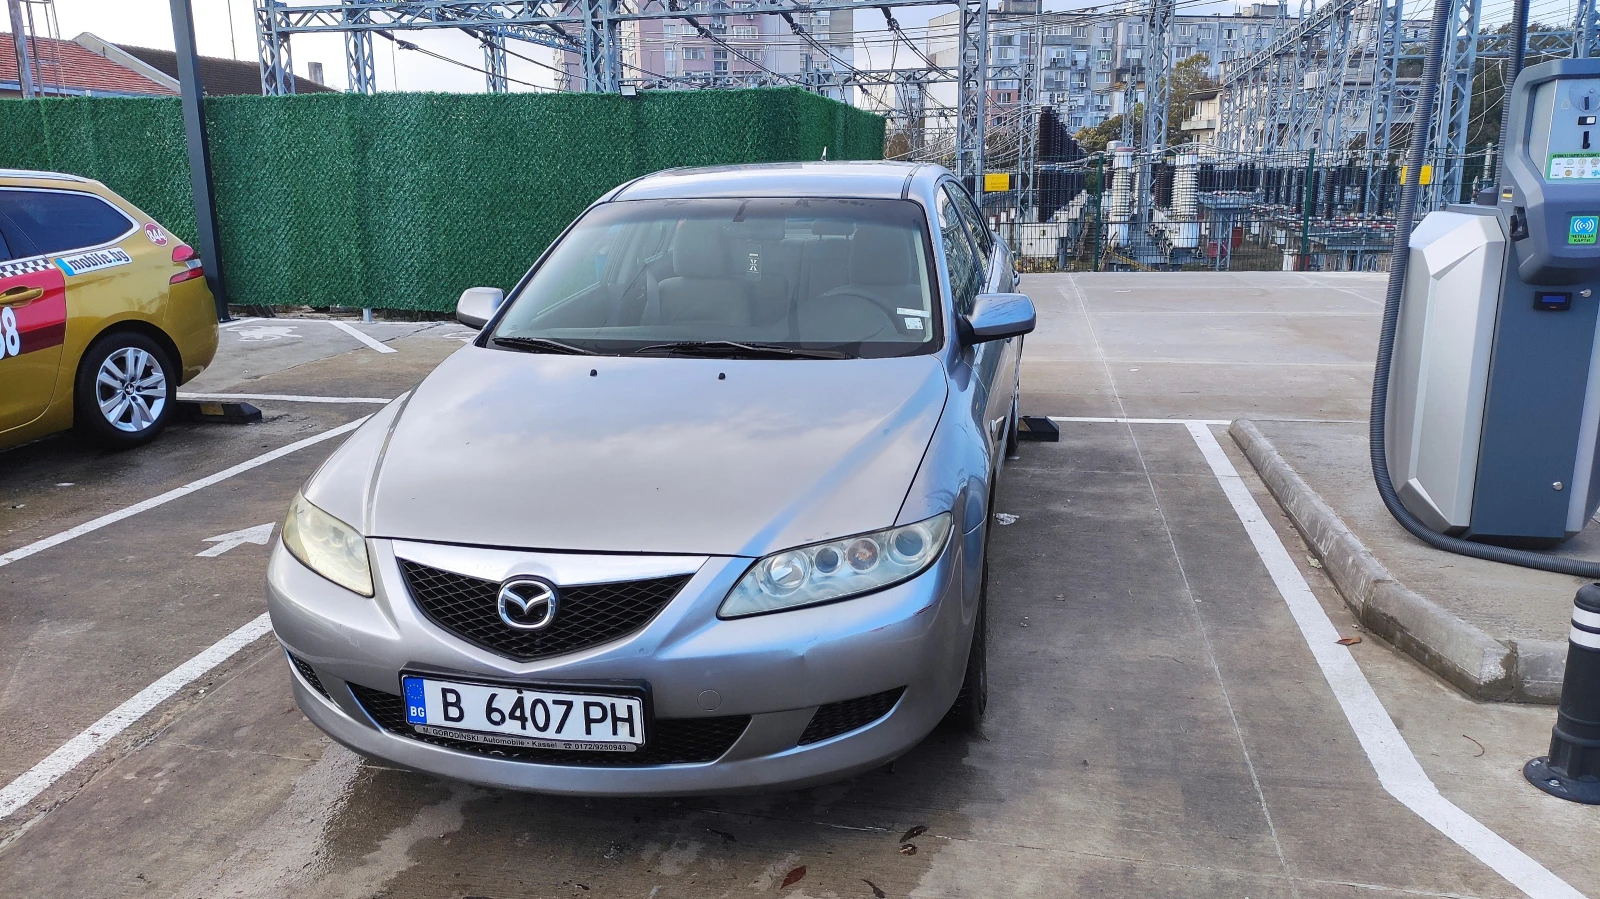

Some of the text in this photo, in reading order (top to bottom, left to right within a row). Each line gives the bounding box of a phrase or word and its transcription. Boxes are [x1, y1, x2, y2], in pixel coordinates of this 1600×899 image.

[68, 250, 130, 271] mobile.bg
[410, 705, 425, 718] BG
[441, 687, 636, 738] B 6407 PH
[433, 728, 479, 741] GORODINSKI
[483, 736, 525, 746] Automobile
[532, 741, 557, 749] Kassel
